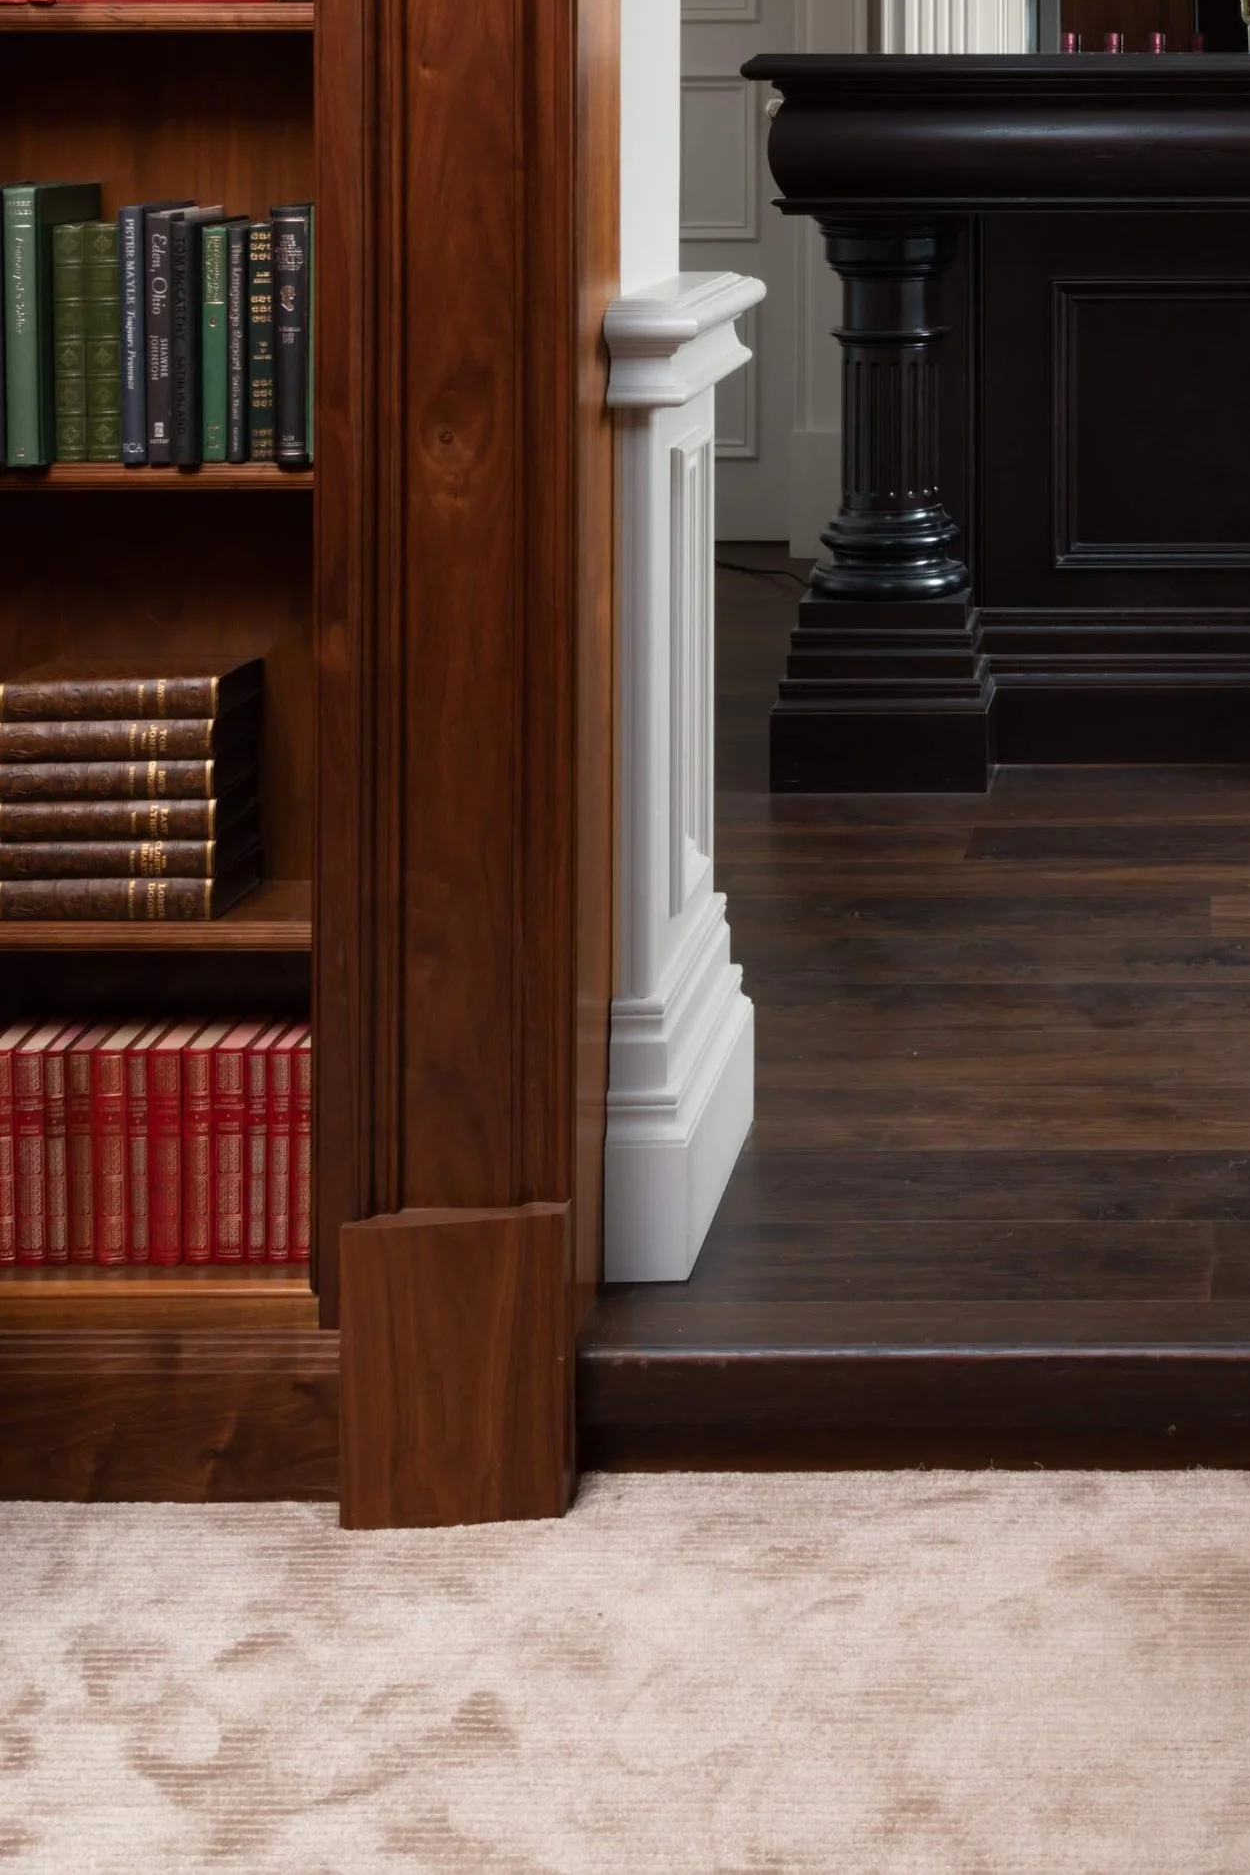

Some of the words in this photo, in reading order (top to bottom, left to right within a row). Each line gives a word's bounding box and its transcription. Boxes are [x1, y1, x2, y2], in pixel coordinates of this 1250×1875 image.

[125, 218, 136, 257] PETER
[149, 233, 168, 272] Eden,
[175, 238, 186, 266] TOM
[126, 260, 136, 304] MAYLE
[151, 277, 168, 315] Ohio
[175, 270, 187, 342] McCARTHY
[149, 334, 160, 381] JOHNSON
[160, 337, 169, 378] SHAWNE
[159, 729, 168, 752] TOM
